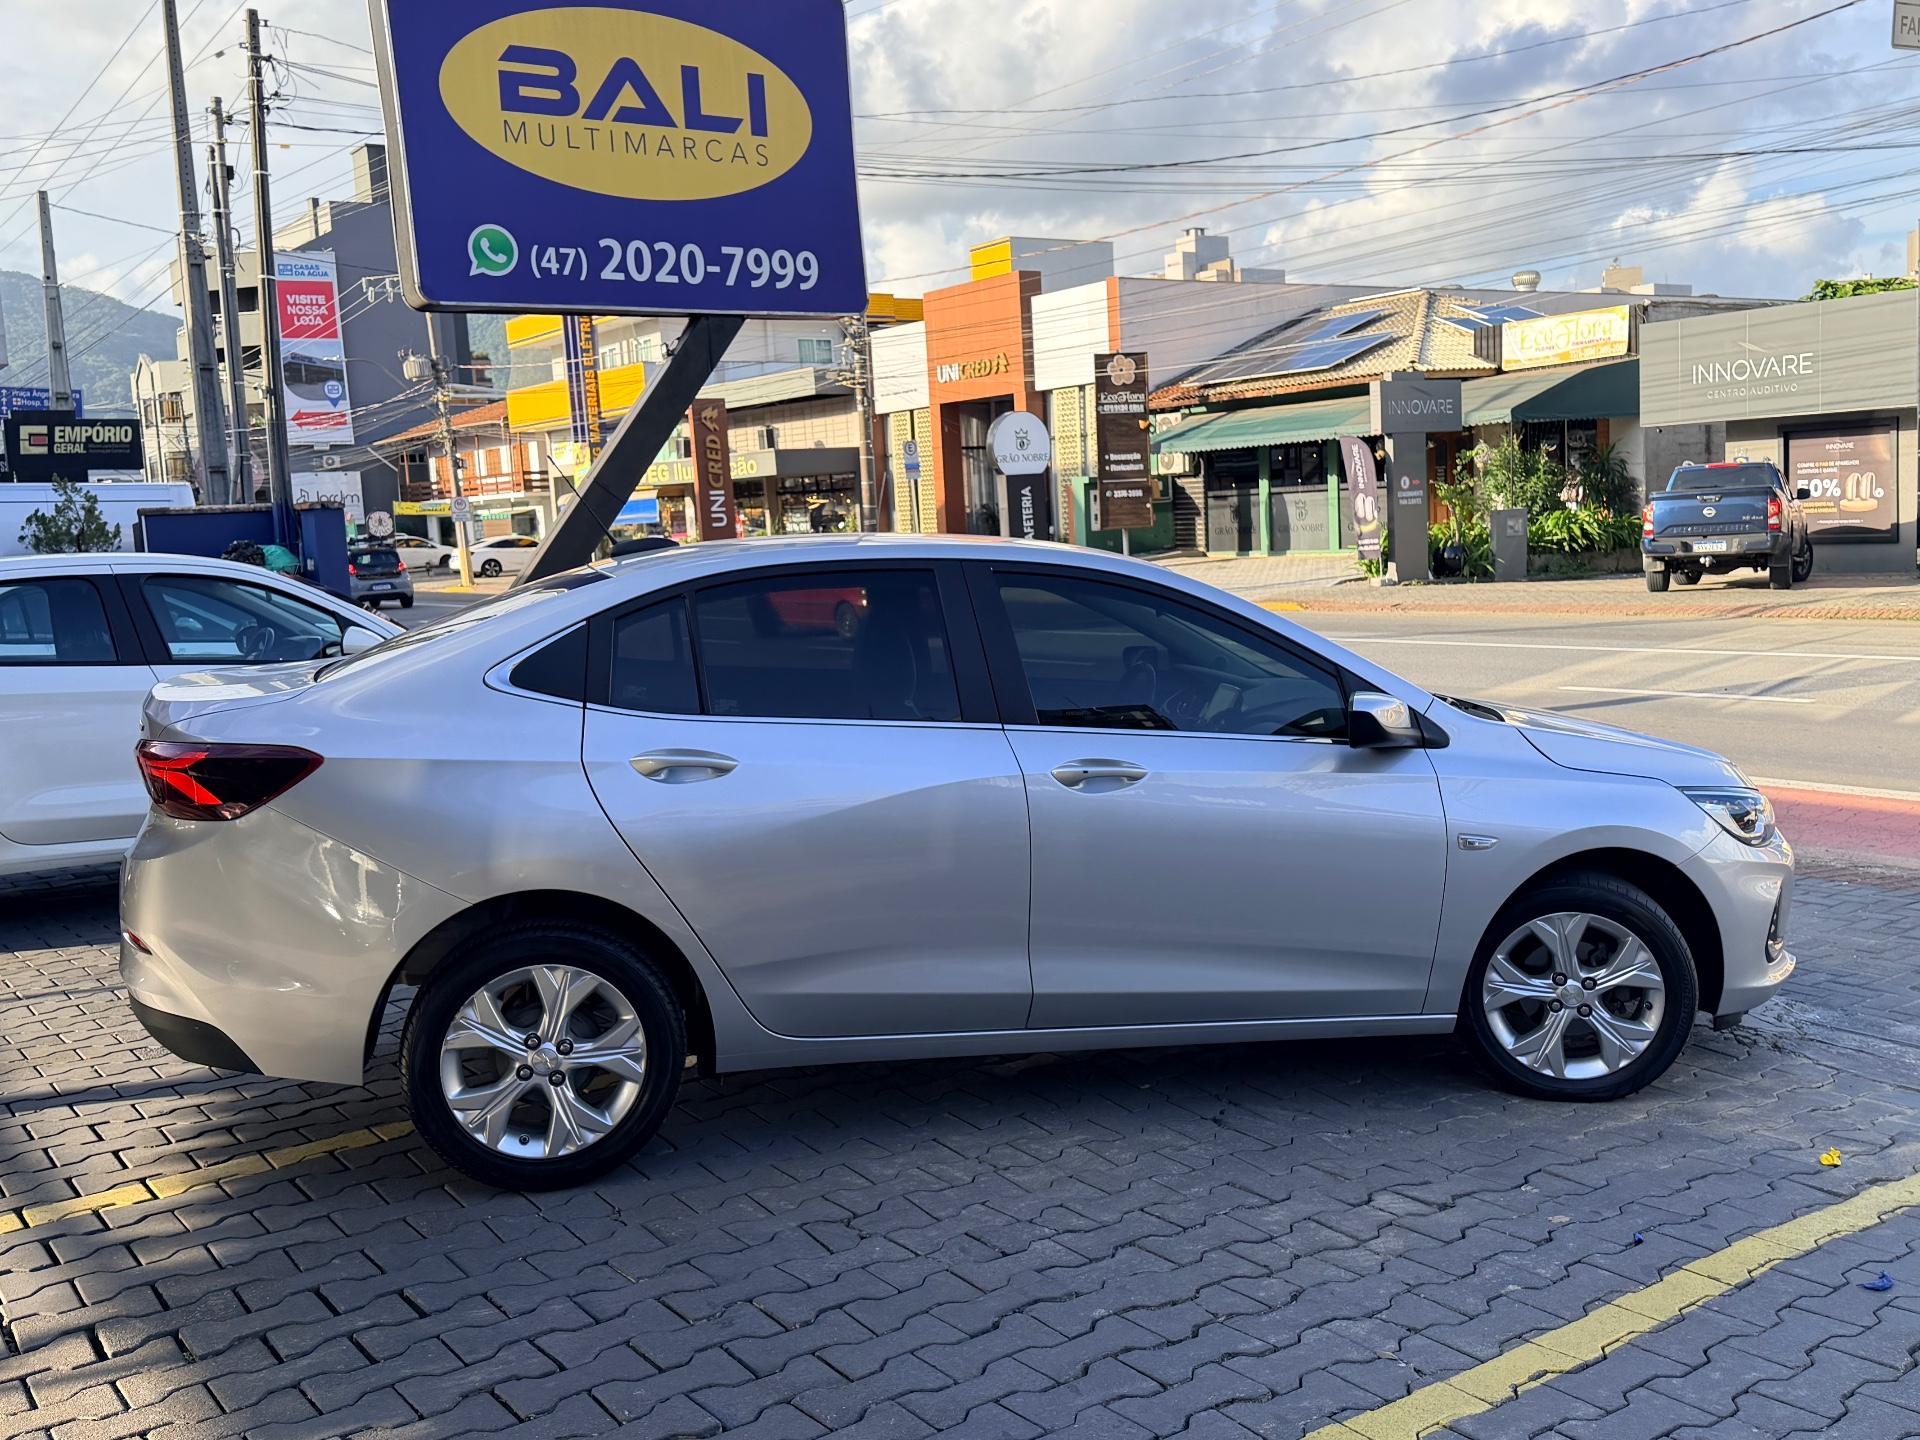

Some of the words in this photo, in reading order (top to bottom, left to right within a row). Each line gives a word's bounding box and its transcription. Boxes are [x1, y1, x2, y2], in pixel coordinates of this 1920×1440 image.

[497, 44, 769, 138] BALI
[503, 119, 770, 167] MULTIMARCAS
[530, 244, 588, 281] (47)
[598, 238, 819, 290] 2020-7999
[286, 294, 326, 304] VISITE
[287, 305, 328, 315] NOSSA
[294, 316, 324, 326] LOJA
[936, 358, 992, 384] UNICRED
[1692, 352, 1814, 385] INNOVARE
[1706, 387, 1746, 399] CENTRO
[1750, 383, 1798, 396] AUDITIVO
[585, 370, 601, 443] MATERIAIS
[1388, 399, 1454, 415] INNOVARE
[54, 422, 133, 443] EMPÓRIO
[53, 443, 87, 454] GERAL
[997, 453, 1020, 464] GRÃO
[1021, 453, 1048, 463] NOBRE
[705, 434, 728, 528] UNICRED
[1797, 478, 1841, 498] 50%
